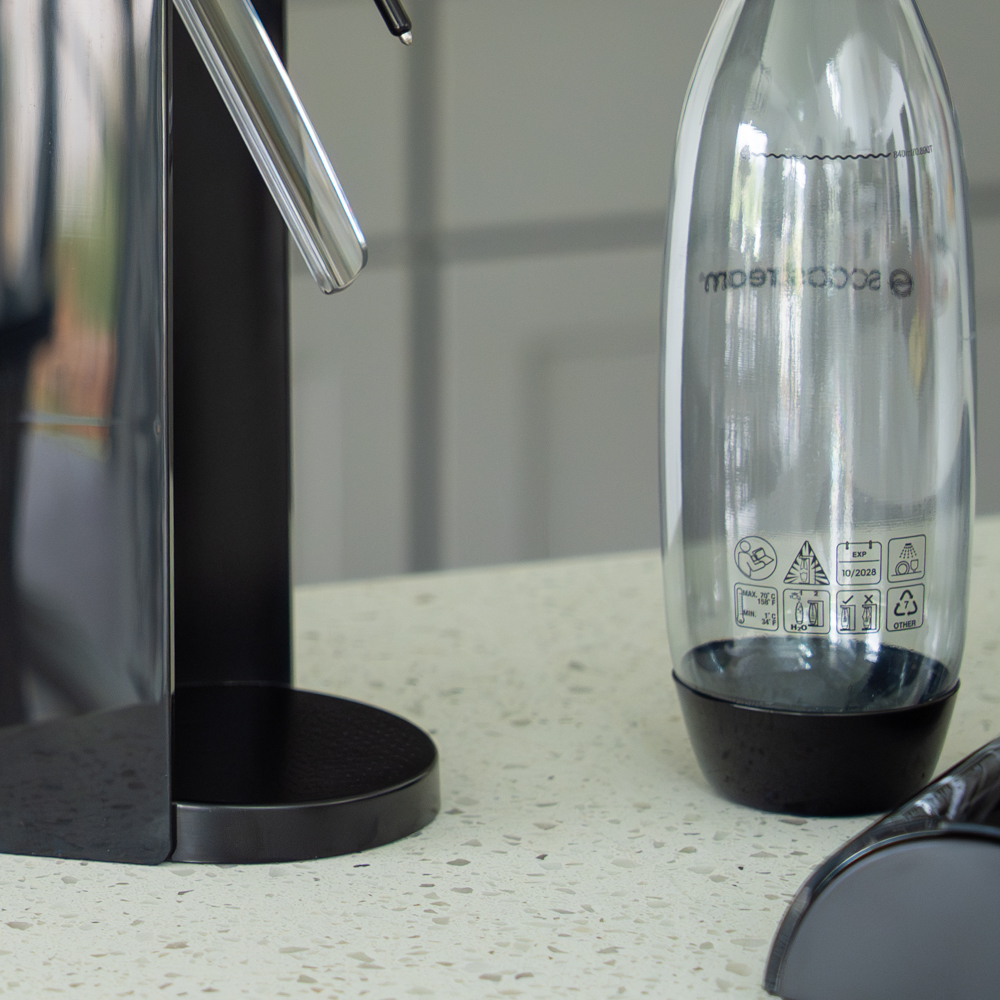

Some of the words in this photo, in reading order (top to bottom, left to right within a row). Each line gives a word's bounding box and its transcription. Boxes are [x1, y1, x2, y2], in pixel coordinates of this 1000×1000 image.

[842, 568, 877, 578] 10/2028
[742, 589, 758, 598] MAX.
[903, 600, 909, 609] 7
[743, 609, 757, 618] MIN.
[893, 619, 917, 630] OTHER
